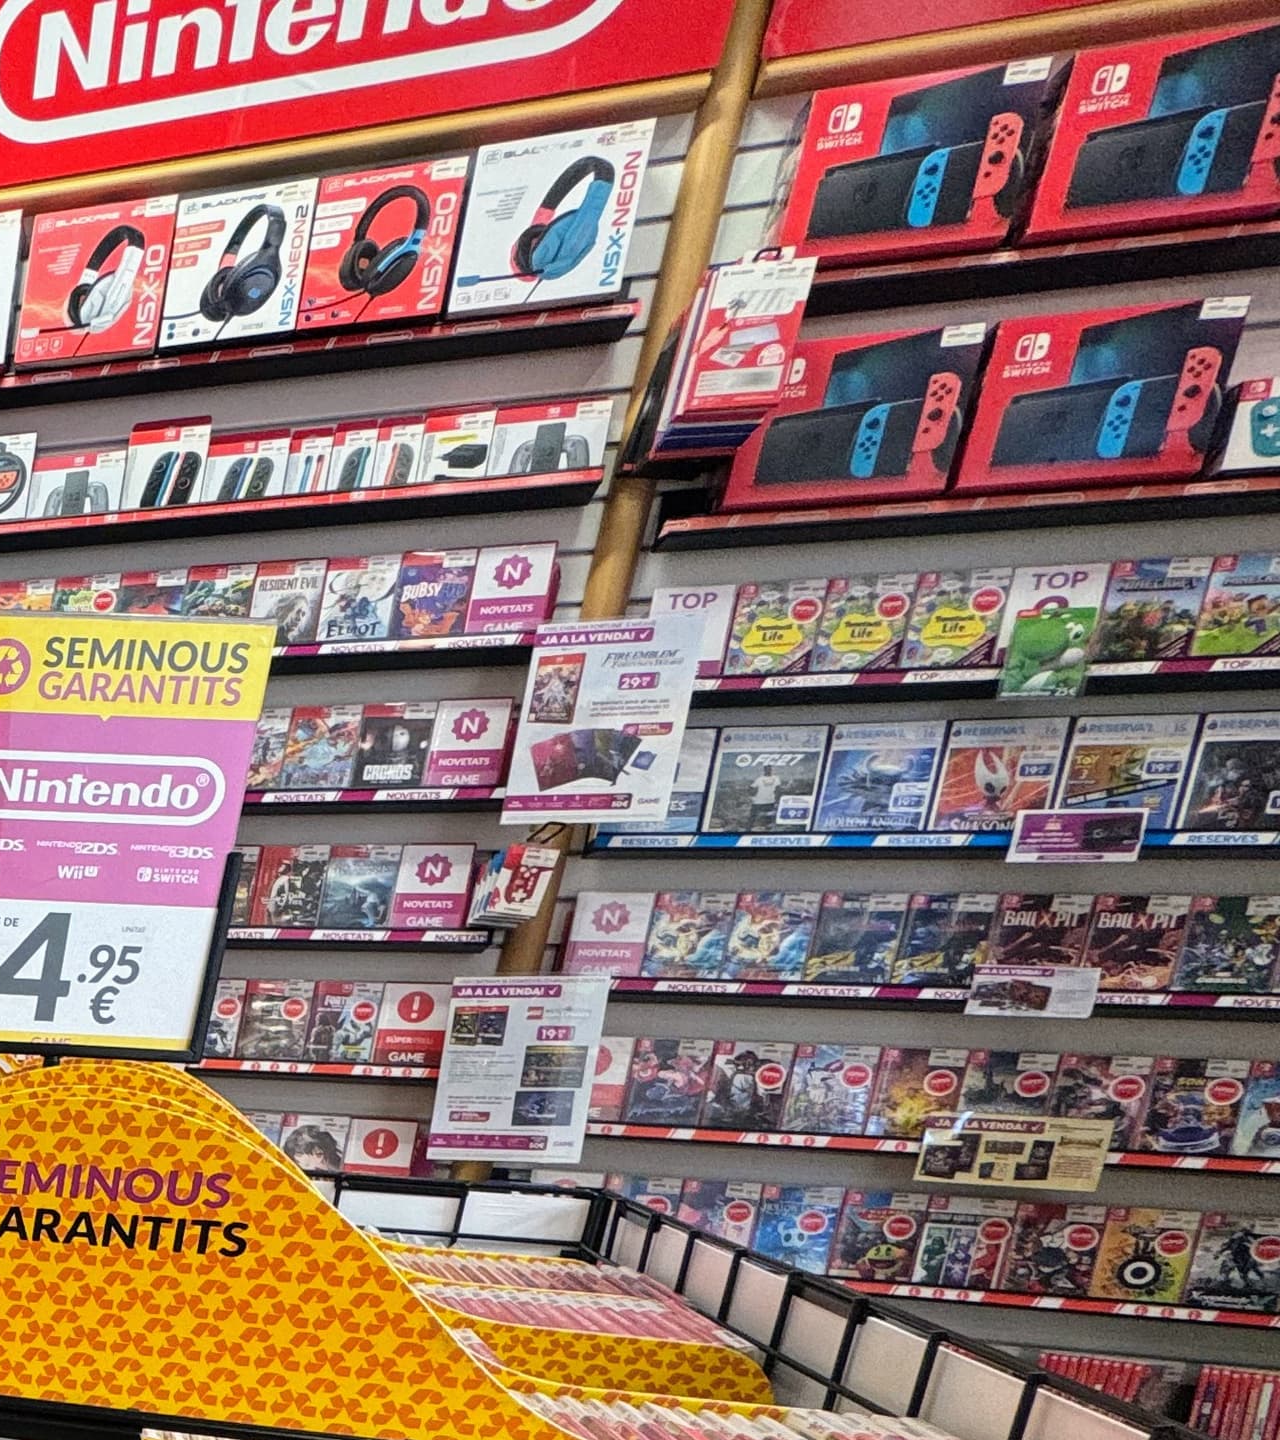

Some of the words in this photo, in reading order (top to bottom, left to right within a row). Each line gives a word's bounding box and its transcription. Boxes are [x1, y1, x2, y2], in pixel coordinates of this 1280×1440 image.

[599, 150, 643, 287] NSX-NEON
[417, 192, 458, 310] NSX-20
[132, 245, 165, 346] NSX-10
[258, 577, 297, 592] RESIDENT
[301, 575, 319, 590] EVIL
[1032, 572, 1089, 590] TOP
[669, 593, 717, 611] TOP
[480, 603, 534, 615] NOVETATS
[542, 636, 558, 645] JA
[559, 635, 568, 644] A
[571, 634, 586, 643] LA
[589, 631, 634, 642] VENDA!
[43, 636, 249, 673] SEMINOUS
[39, 671, 243, 707] GARANTITS
[438, 756, 489, 767] NOVETATS
[442, 773, 480, 785] GAME
[622, 836, 678, 847] RESERVES
[751, 835, 811, 847] RESERVES
[887, 835, 952, 846] RESERVES
[1187, 833, 1259, 845] RESERVES
[152, 874, 198, 885] SWITCH
[403, 898, 453, 910] NOVETATS
[4, 916, 19, 928] DE
[406, 915, 443, 928] GAME
[578, 947, 631, 959] NOVETATS
[457, 988, 474, 996] JA
[475, 988, 484, 996] A
[486, 987, 500, 996] LA
[502, 987, 544, 996] VENDA!
[797, 987, 860, 998] NOVETATS
[90, 986, 116, 1025] €
[389, 1051, 425, 1064] GAME
[981, 1121, 1028, 1132] VENDA!
